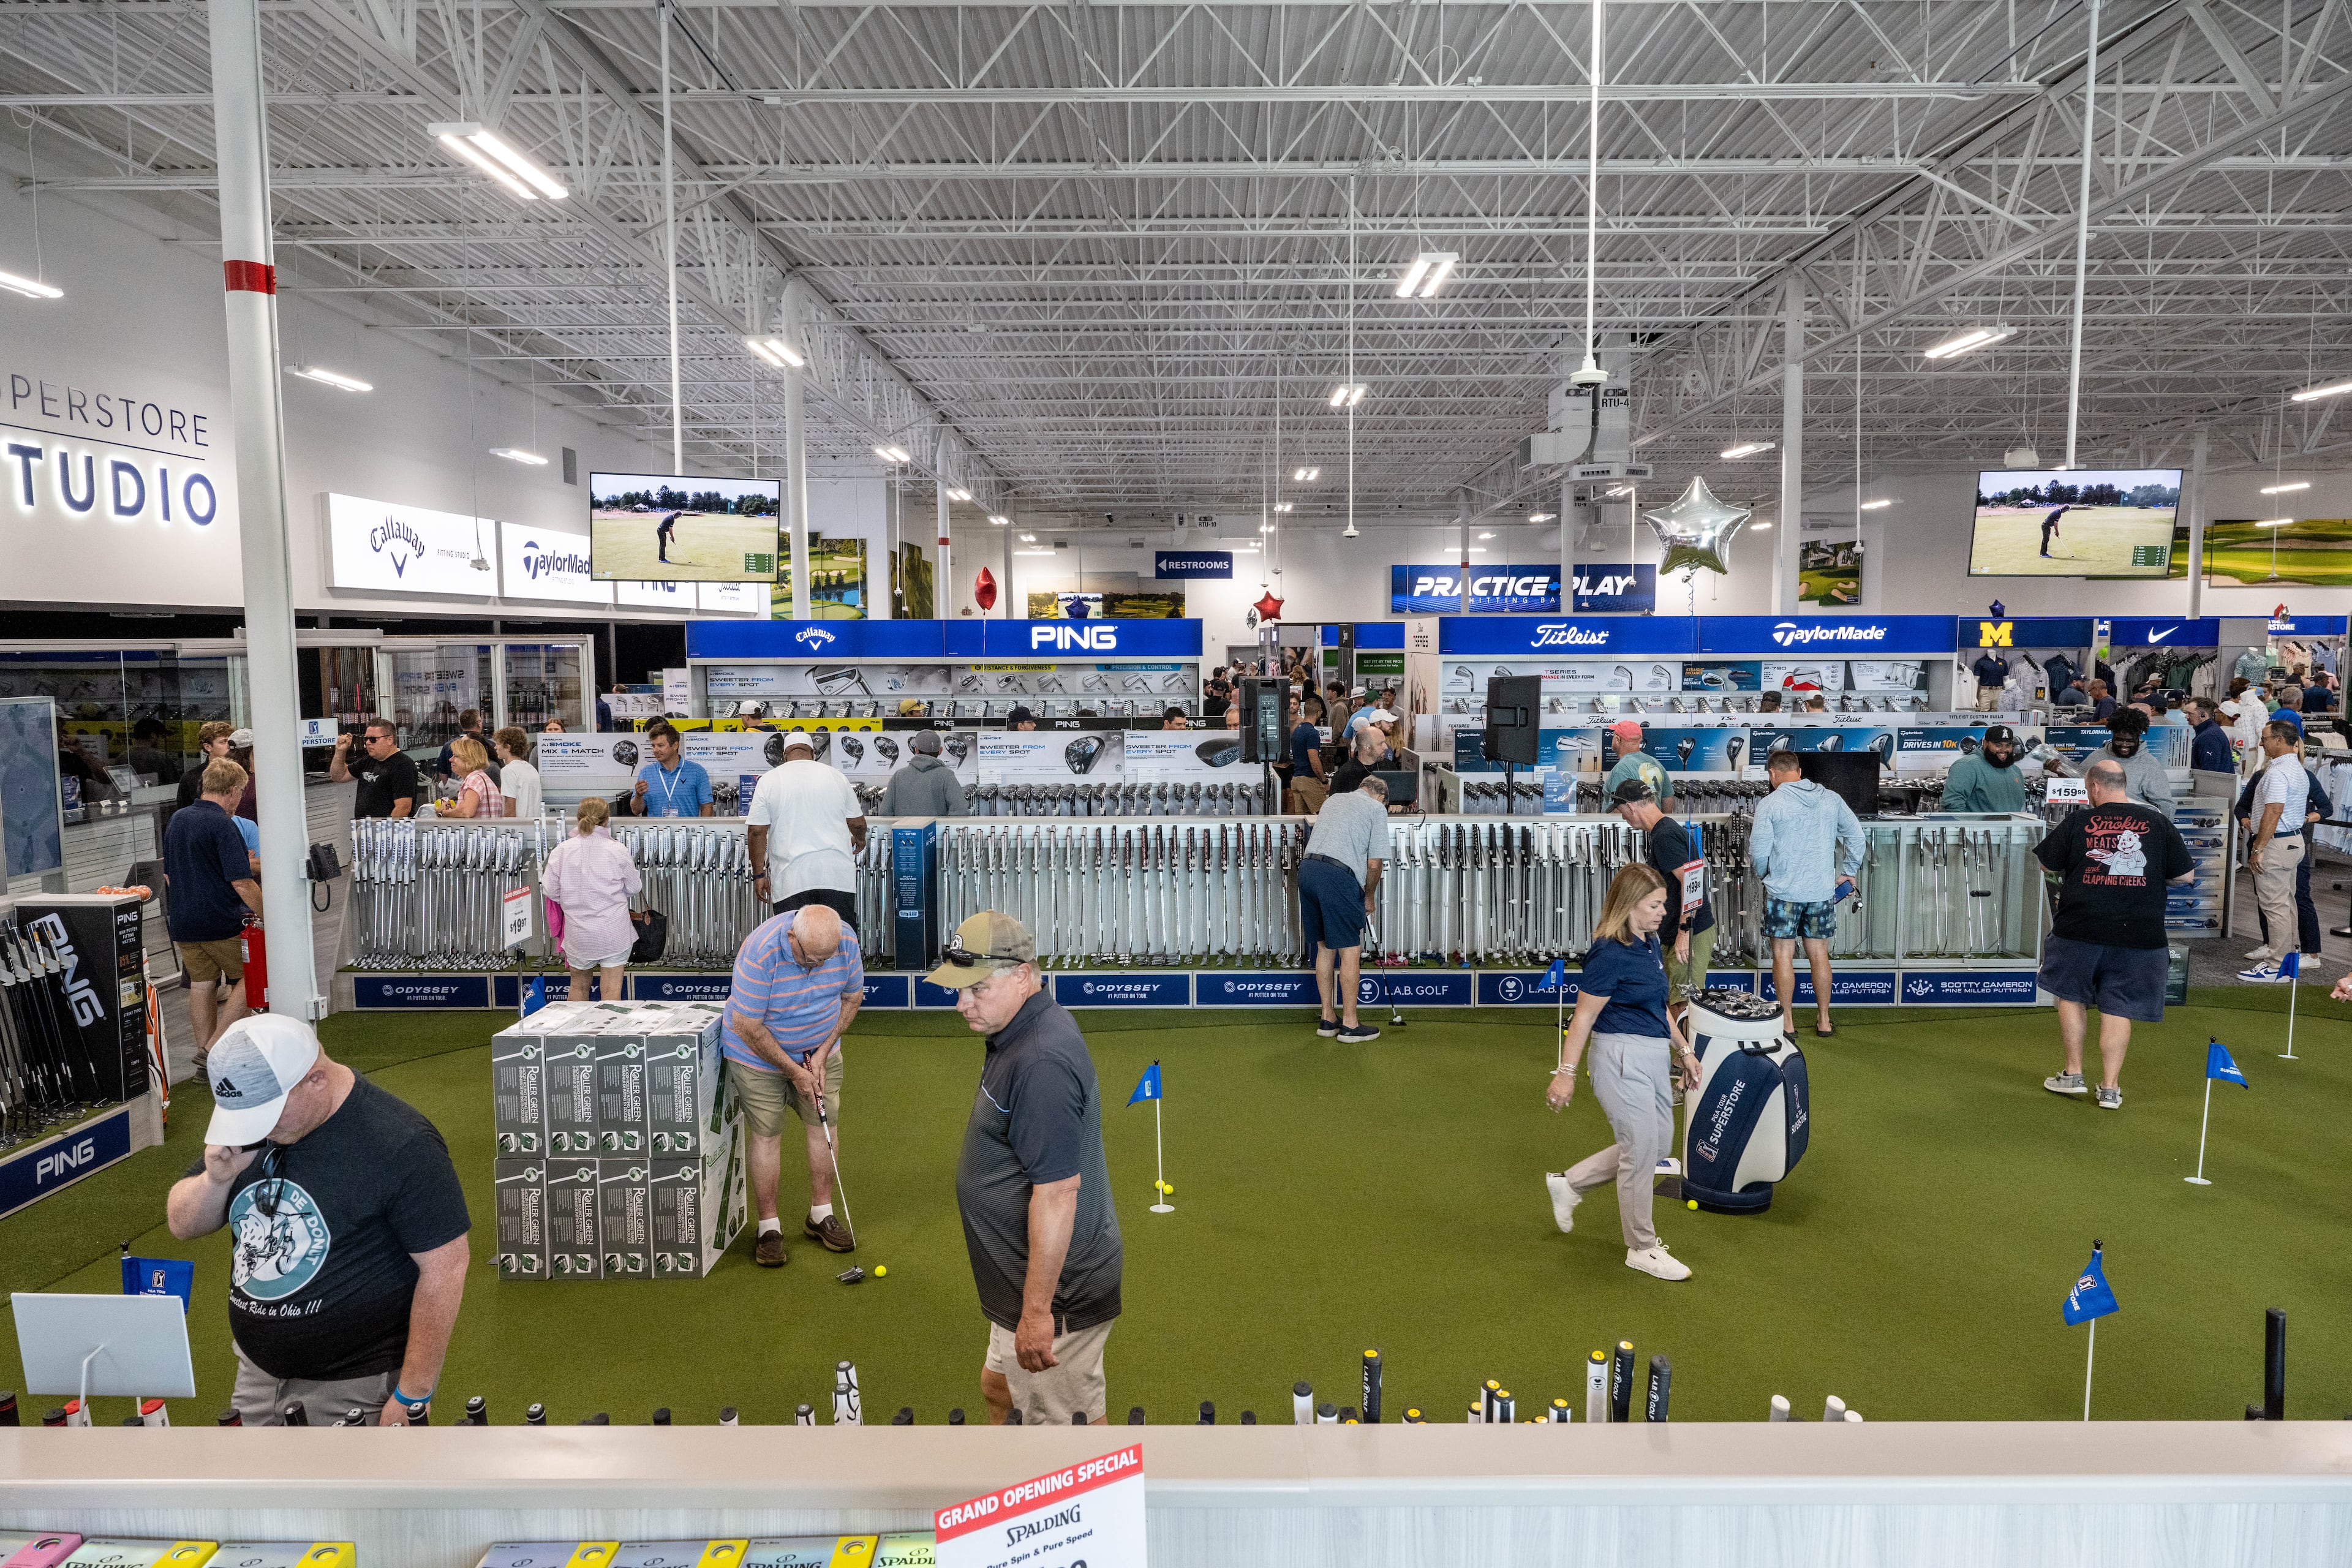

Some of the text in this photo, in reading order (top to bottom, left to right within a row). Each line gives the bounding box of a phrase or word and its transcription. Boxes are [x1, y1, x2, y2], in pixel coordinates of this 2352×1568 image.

[371, 514, 424, 559] Callaway
[437, 549, 454, 557] FITTING
[524, 541, 591, 579] TaylorMad
[1168, 560, 1229, 570] RESTROOMS
[796, 627, 836, 643] Callaway
[1031, 626, 1118, 649] PING
[1531, 623, 1609, 647] Titleist
[1773, 622, 1887, 646] TaylorMade
[1980, 622, 2013, 647] M
[1586, 715, 1617, 725] Titleist
[1833, 714, 1863, 723] Titleist
[408, 736, 429, 745] STUDIO
[2084, 815, 2150, 834] Smokin'
[2086, 837, 2117, 848] MEATS
[2086, 863, 2102, 872] and
[2083, 874, 2147, 887] CLAPPING CHEEKS
[117, 911, 138, 925] PING
[24, 913, 107, 1027] PING
[1384, 986, 1449, 995] L.A.B. GOLF
[527, 1066, 539, 1095] ROLLER
[579, 1065, 592, 1095] ROLLER
[215, 1088, 243, 1098] adidas
[1716, 1094, 1728, 1109] TOUR
[1710, 1079, 1746, 1145] SUPERSTORE
[37, 1137, 94, 1185] PING
[289, 1189, 324, 1266] DE DONUT
[249, 1302, 266, 1315] Ride
[268, 1305, 277, 1316] in
[280, 1303, 301, 1316] Ohio
[305, 1300, 322, 1314] !!!
[938, 1449, 1138, 1529] GRAND OPENING SPECIAL
[1006, 1504, 1082, 1548] SPALDING
[1011, 1551, 1030, 1564] Spin
[1043, 1542, 1063, 1553] Pure
[1066, 1529, 1093, 1545] Speed
